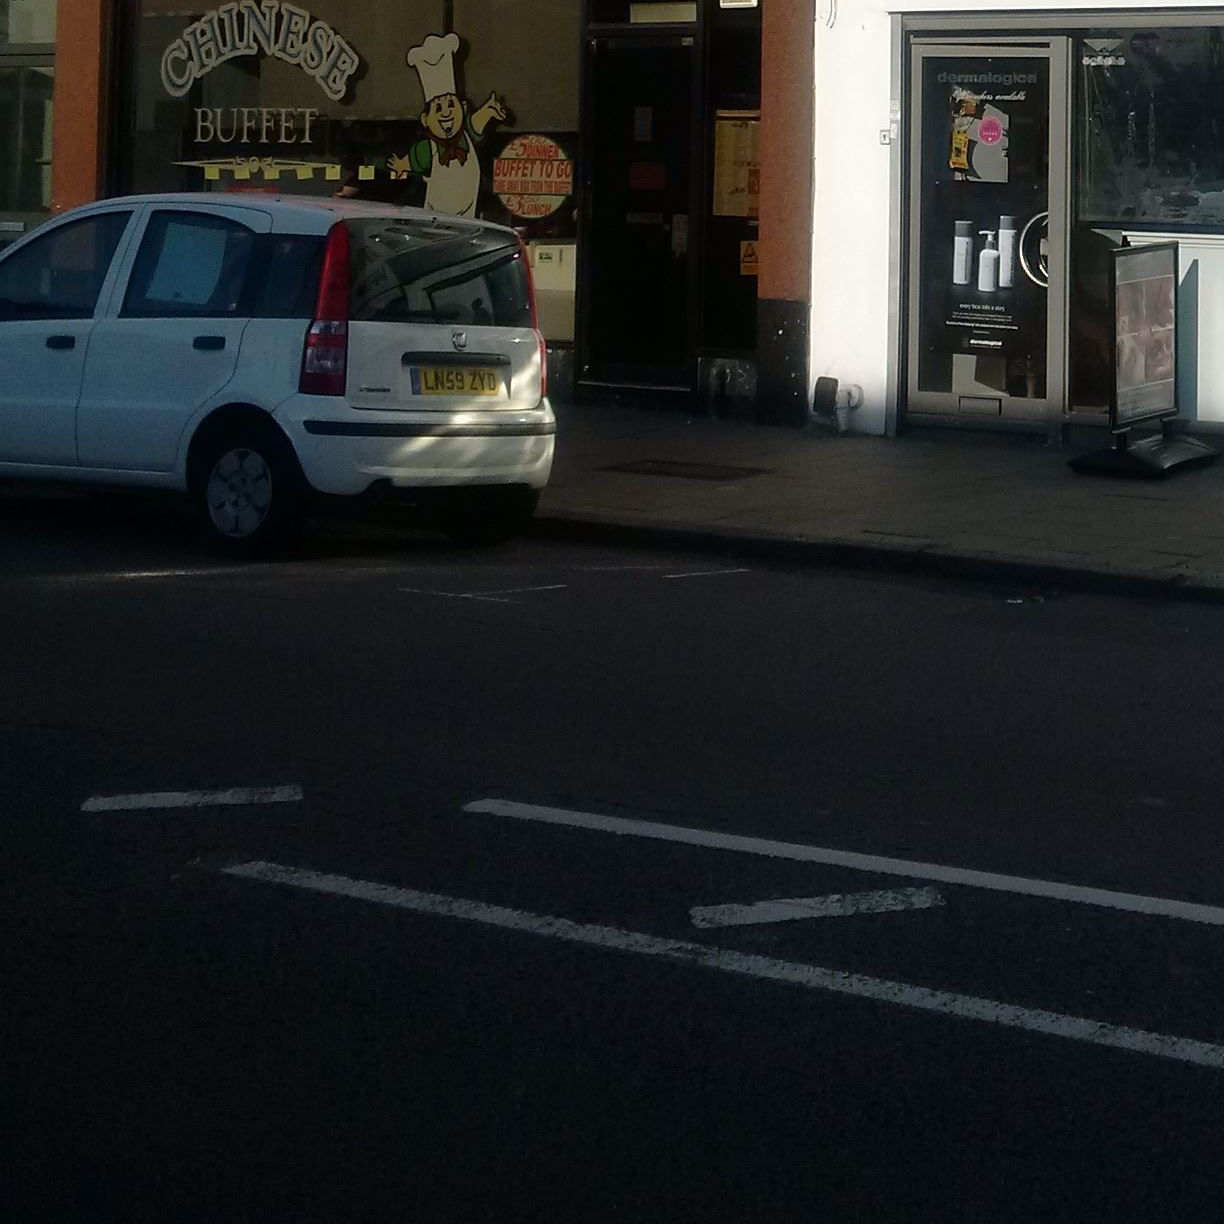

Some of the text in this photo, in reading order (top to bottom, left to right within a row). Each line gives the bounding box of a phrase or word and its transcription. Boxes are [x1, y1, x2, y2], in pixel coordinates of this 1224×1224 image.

[161, 0, 359, 102] CHINESE
[937, 71, 1038, 86] dermalogica
[195, 107, 319, 143] BUFFET
[495, 159, 572, 178] BUFFET TO GO
[424, 370, 497, 391] LN59 ZYD
